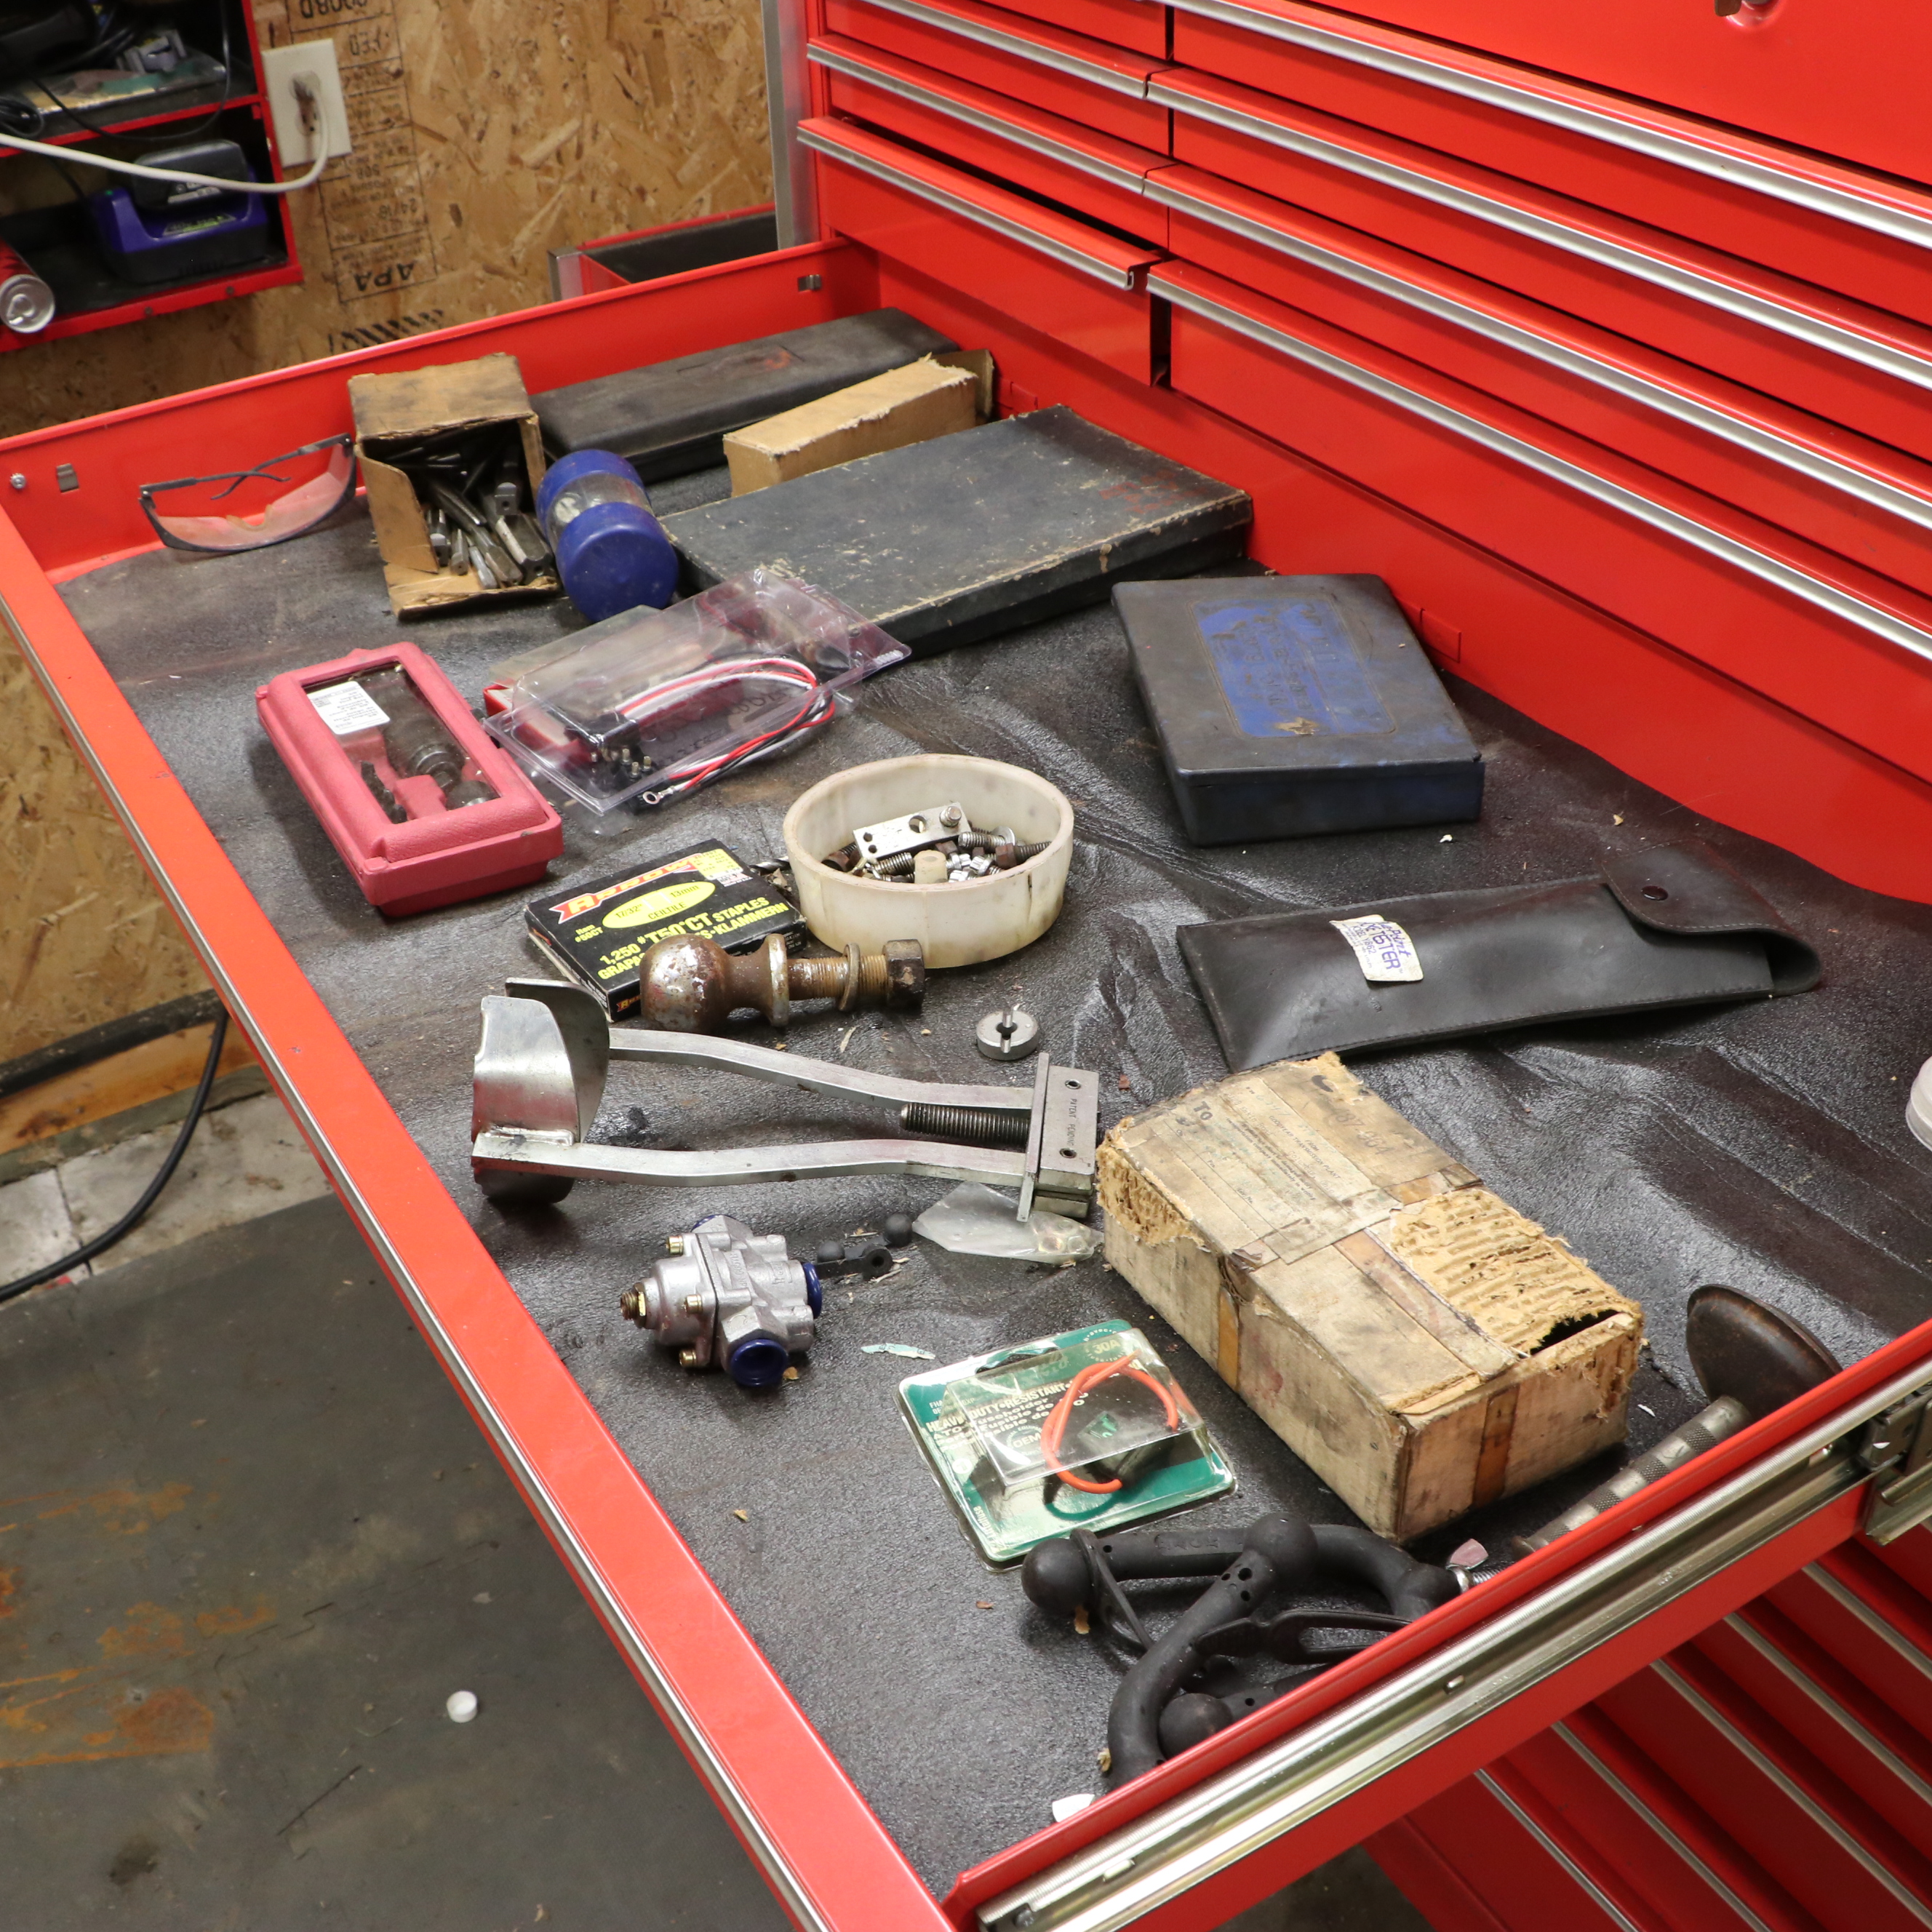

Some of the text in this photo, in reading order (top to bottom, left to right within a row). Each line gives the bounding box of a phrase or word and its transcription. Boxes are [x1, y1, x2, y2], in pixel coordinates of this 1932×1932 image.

[354, 263, 416, 292] APA
[567, 859, 698, 914] ARROW
[668, 884, 700, 899] 13mm
[647, 902, 687, 920] CEILTILE
[575, 923, 595, 935] Item
[599, 943, 641, 967] 1,250
[712, 896, 770, 922] STAPLES
[1069, 1098, 1077, 1119] PATENT
[1193, 1101, 1213, 1122] To
[1066, 1125, 1076, 1146] PENDING
[1304, 1139, 1320, 1151] FROM
[1269, 1115, 1294, 1137] GOODYEAR
[1293, 1135, 1325, 1167] TRANSMISSION
[1321, 1164, 1341, 1180] PLANT
[1092, 1339, 1121, 1356] 30A
[1013, 1435, 1042, 1449] OEM
